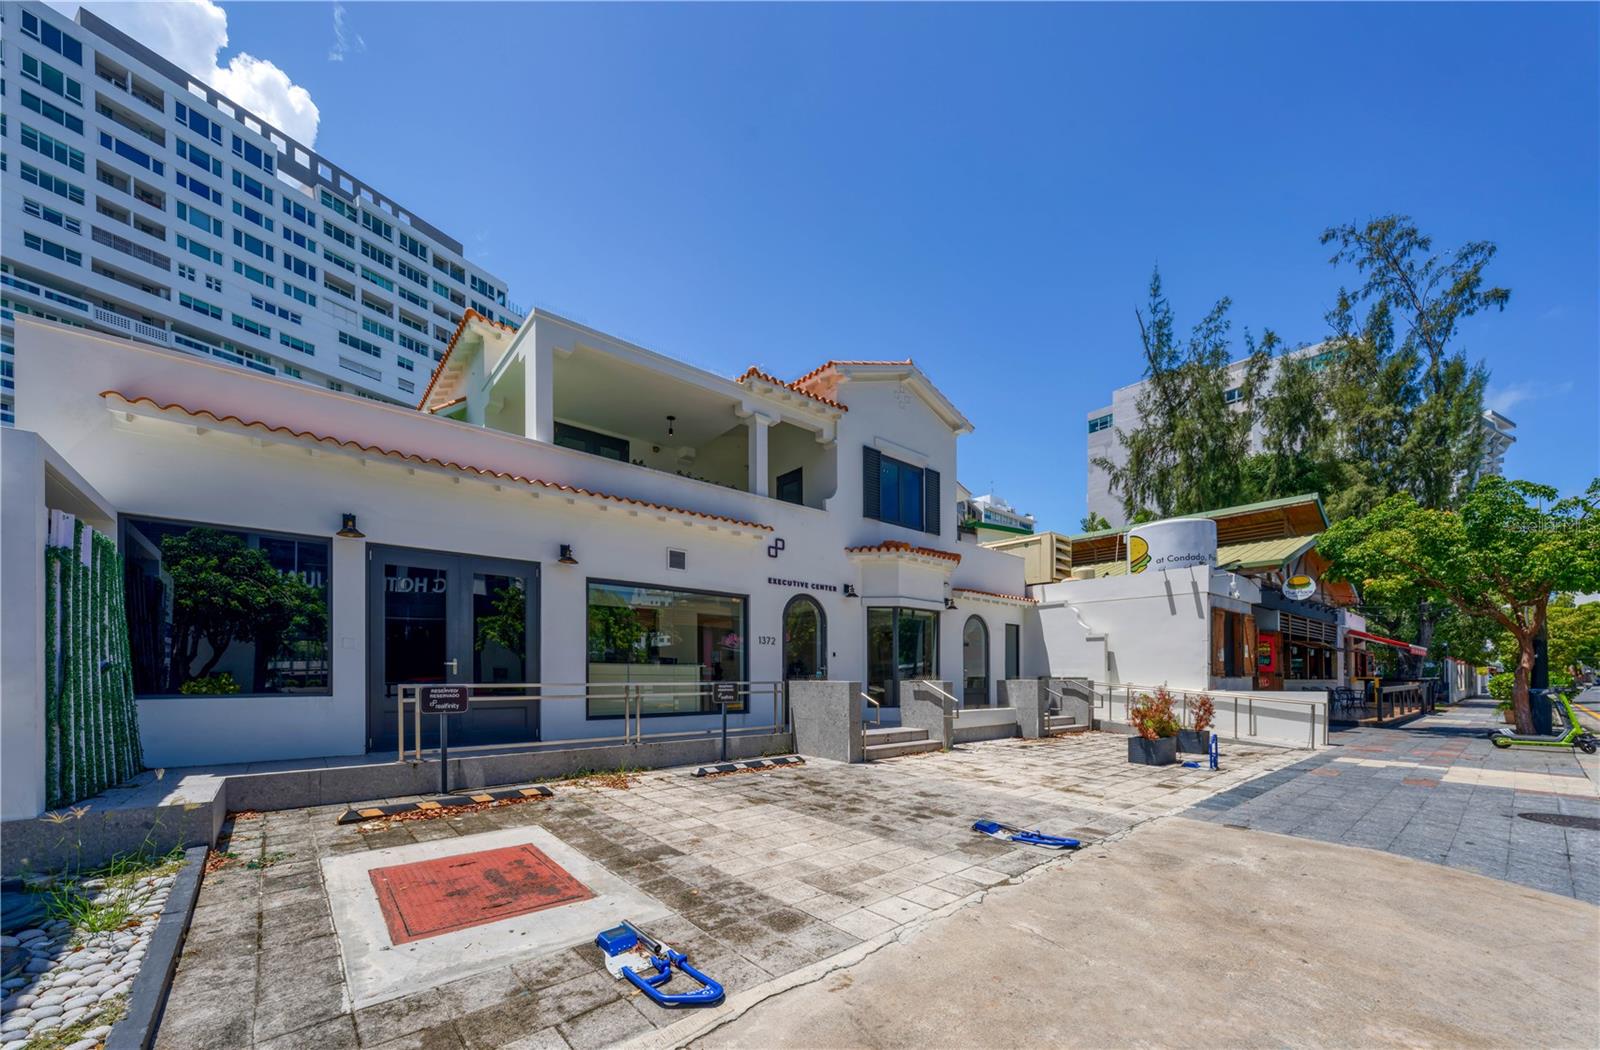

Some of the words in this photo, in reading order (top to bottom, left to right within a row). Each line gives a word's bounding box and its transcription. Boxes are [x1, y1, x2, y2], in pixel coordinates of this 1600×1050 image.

[1156, 556, 1164, 564] at
[1166, 553, 1207, 563] Condado,
[767, 577, 809, 589] EXECUTIVE
[810, 583, 838, 592] CENTER
[758, 635, 776, 646] 1372
